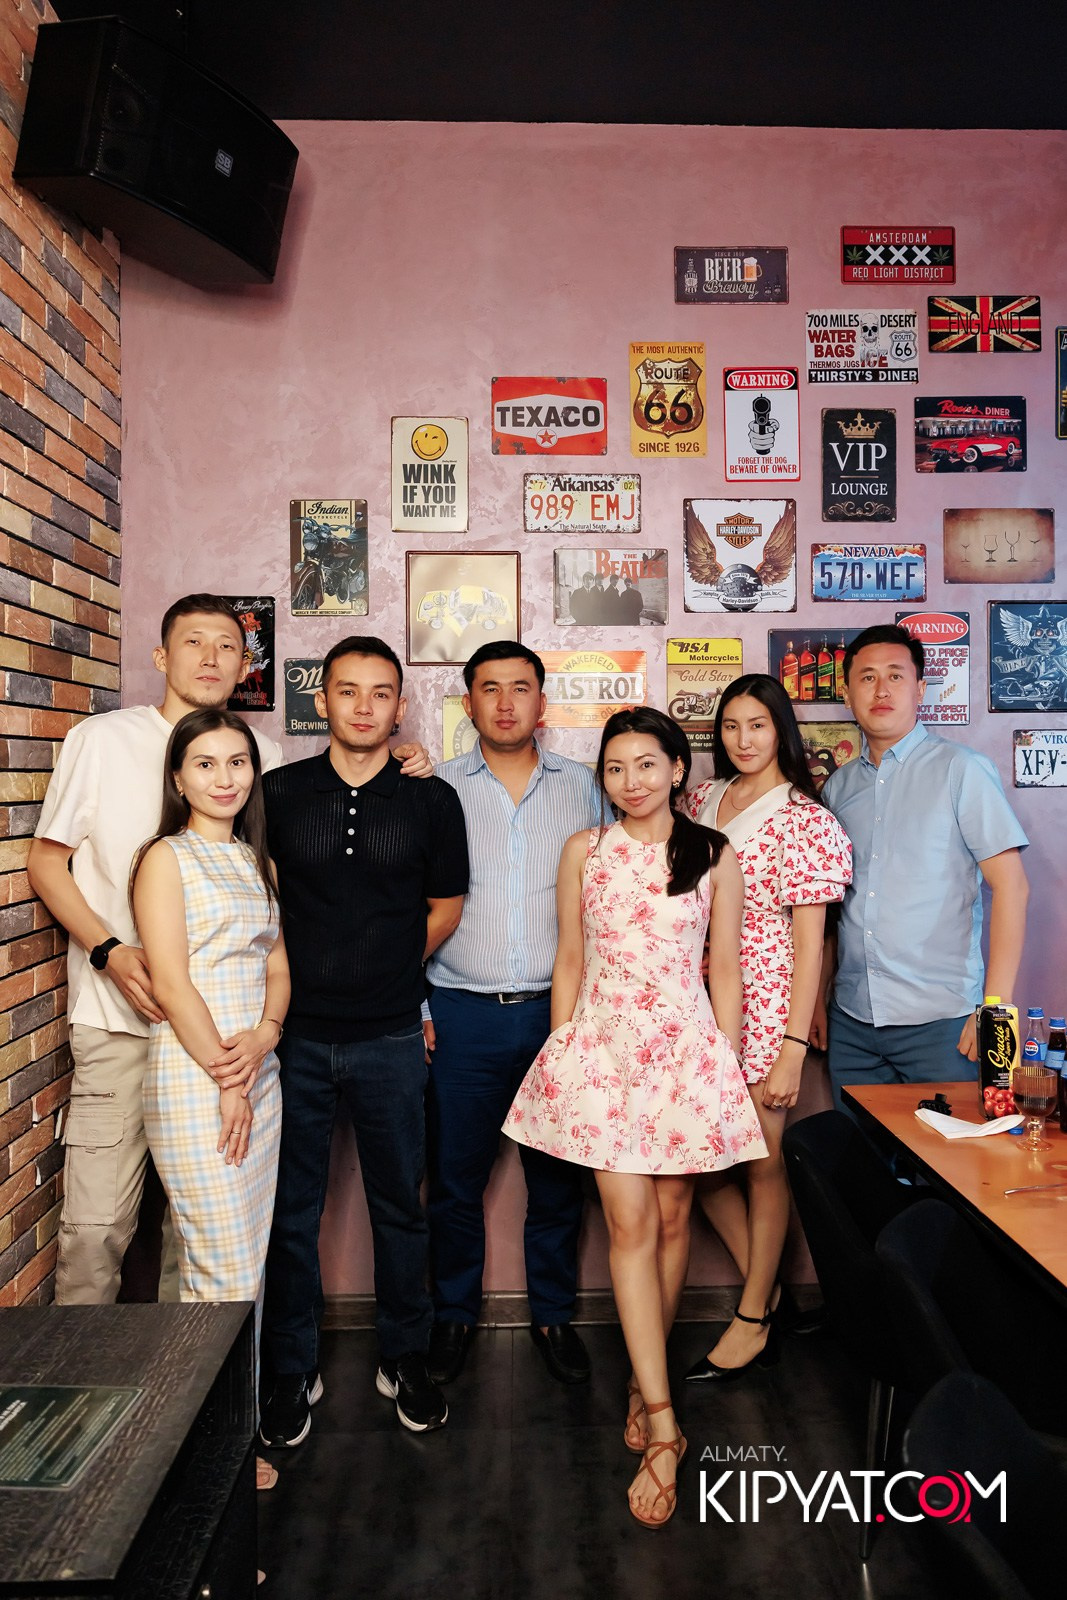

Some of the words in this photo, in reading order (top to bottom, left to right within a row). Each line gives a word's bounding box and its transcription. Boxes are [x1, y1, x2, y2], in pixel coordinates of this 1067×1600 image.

[869, 232, 927, 244] AMSTERDAM
[704, 257, 743, 282] BEER
[852, 267, 869, 279] RED
[874, 267, 899, 279] LIGHT
[904, 267, 944, 279] DISTRICT
[703, 280, 759, 299] Brewery
[807, 314, 828, 328] 700
[829, 314, 860, 328] MILES
[880, 314, 917, 328] DESERT
[949, 312, 1021, 335] ENGLAND
[808, 330, 857, 343] WATER
[632, 346, 645, 354] THE
[647, 346, 665, 354] MOST
[668, 345, 704, 354] AUTHENTIC
[814, 344, 855, 358] BAGS
[895, 342, 913, 357] 66
[843, 360, 860, 368] JUGS
[645, 367, 690, 380] ROUTE
[810, 371, 873, 382] THIRSTY'S
[879, 371, 918, 382] DINER
[731, 374, 789, 387] WARNING
[644, 388, 693, 425] 66
[985, 406, 1010, 416] DINER
[497, 406, 600, 428] TEXACO
[639, 442, 670, 453] SINCE
[675, 442, 700, 453] 1926
[738, 457, 760, 465] FORGET
[829, 442, 887, 472] VIP
[402, 463, 456, 484] WINK
[730, 465, 758, 474] BEWARE
[760, 465, 770, 474] OF
[772, 464, 797, 474] OWNER
[551, 477, 615, 492] Arkansas
[831, 483, 888, 496] LOUNGE
[403, 485, 418, 504] IF
[421, 485, 456, 504] YOU
[307, 501, 349, 515] Indian
[402, 505, 437, 518] WANT
[440, 505, 456, 518] ME
[530, 494, 575, 521] 989
[591, 494, 635, 521] EMJ
[728, 517, 751, 525] MOTOR
[720, 526, 760, 535] HARLEY-DAVIDSON
[843, 547, 896, 558] NEVADA
[820, 562, 863, 590] 570
[875, 562, 918, 590] WEF
[679, 642, 709, 653] BSA
[924, 648, 936, 657] TO
[939, 648, 968, 657] PRICE
[563, 655, 614, 671] WAKEFIELD
[952, 658, 966, 667] OF
[680, 669, 706, 682] Gold
[708, 669, 733, 682] Star
[601, 706, 617, 720] OIL
[934, 705, 967, 713] EXPECT
[291, 719, 328, 730] BREWING
